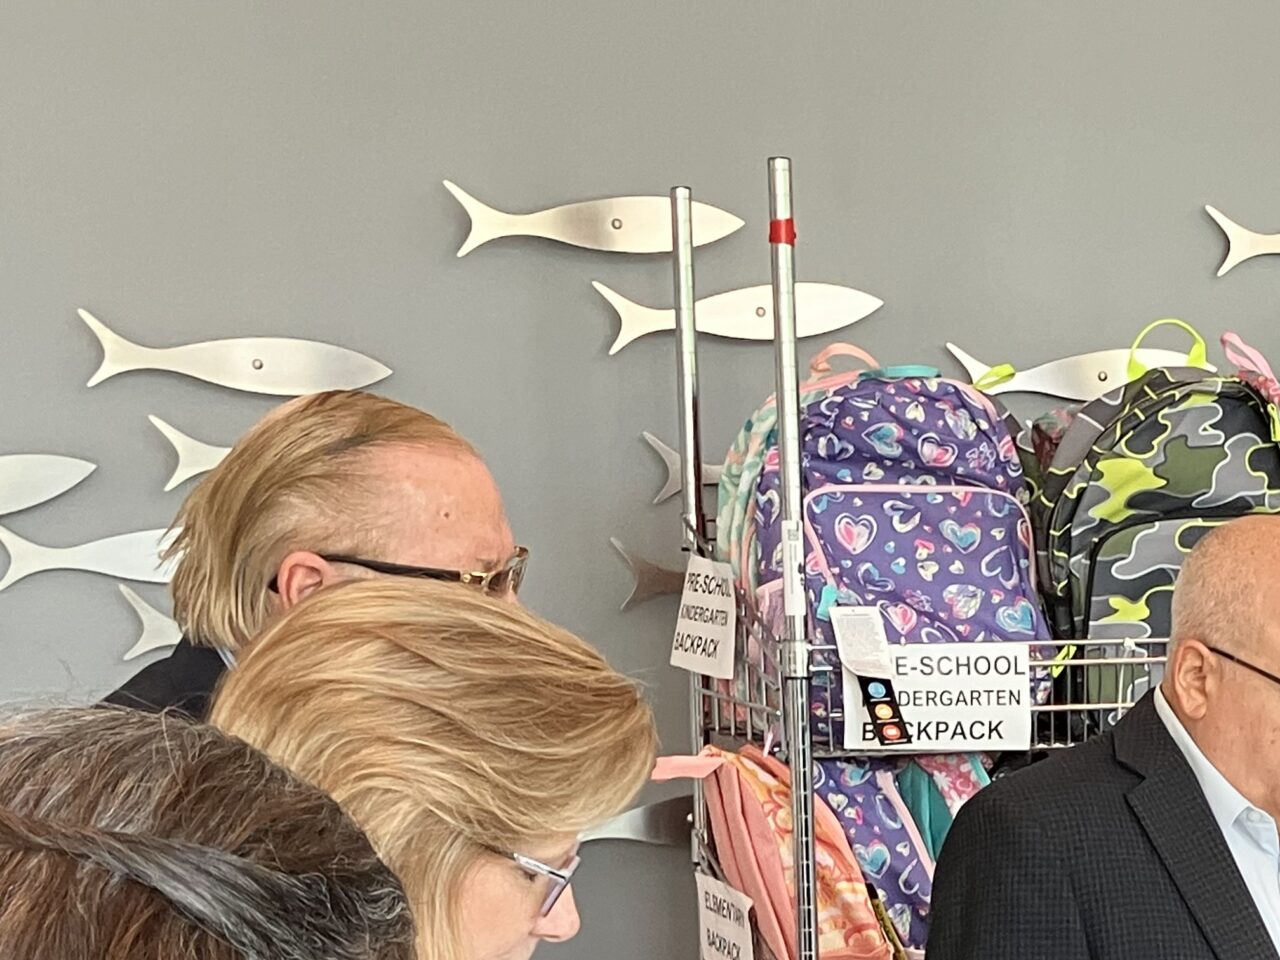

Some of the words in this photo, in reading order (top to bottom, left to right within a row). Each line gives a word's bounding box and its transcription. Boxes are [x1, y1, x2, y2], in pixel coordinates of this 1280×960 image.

[673, 631, 721, 660] BACKPACK
[894, 655, 1026, 677] E-SCHOOL
[861, 720, 1004, 741] BCKPACK
